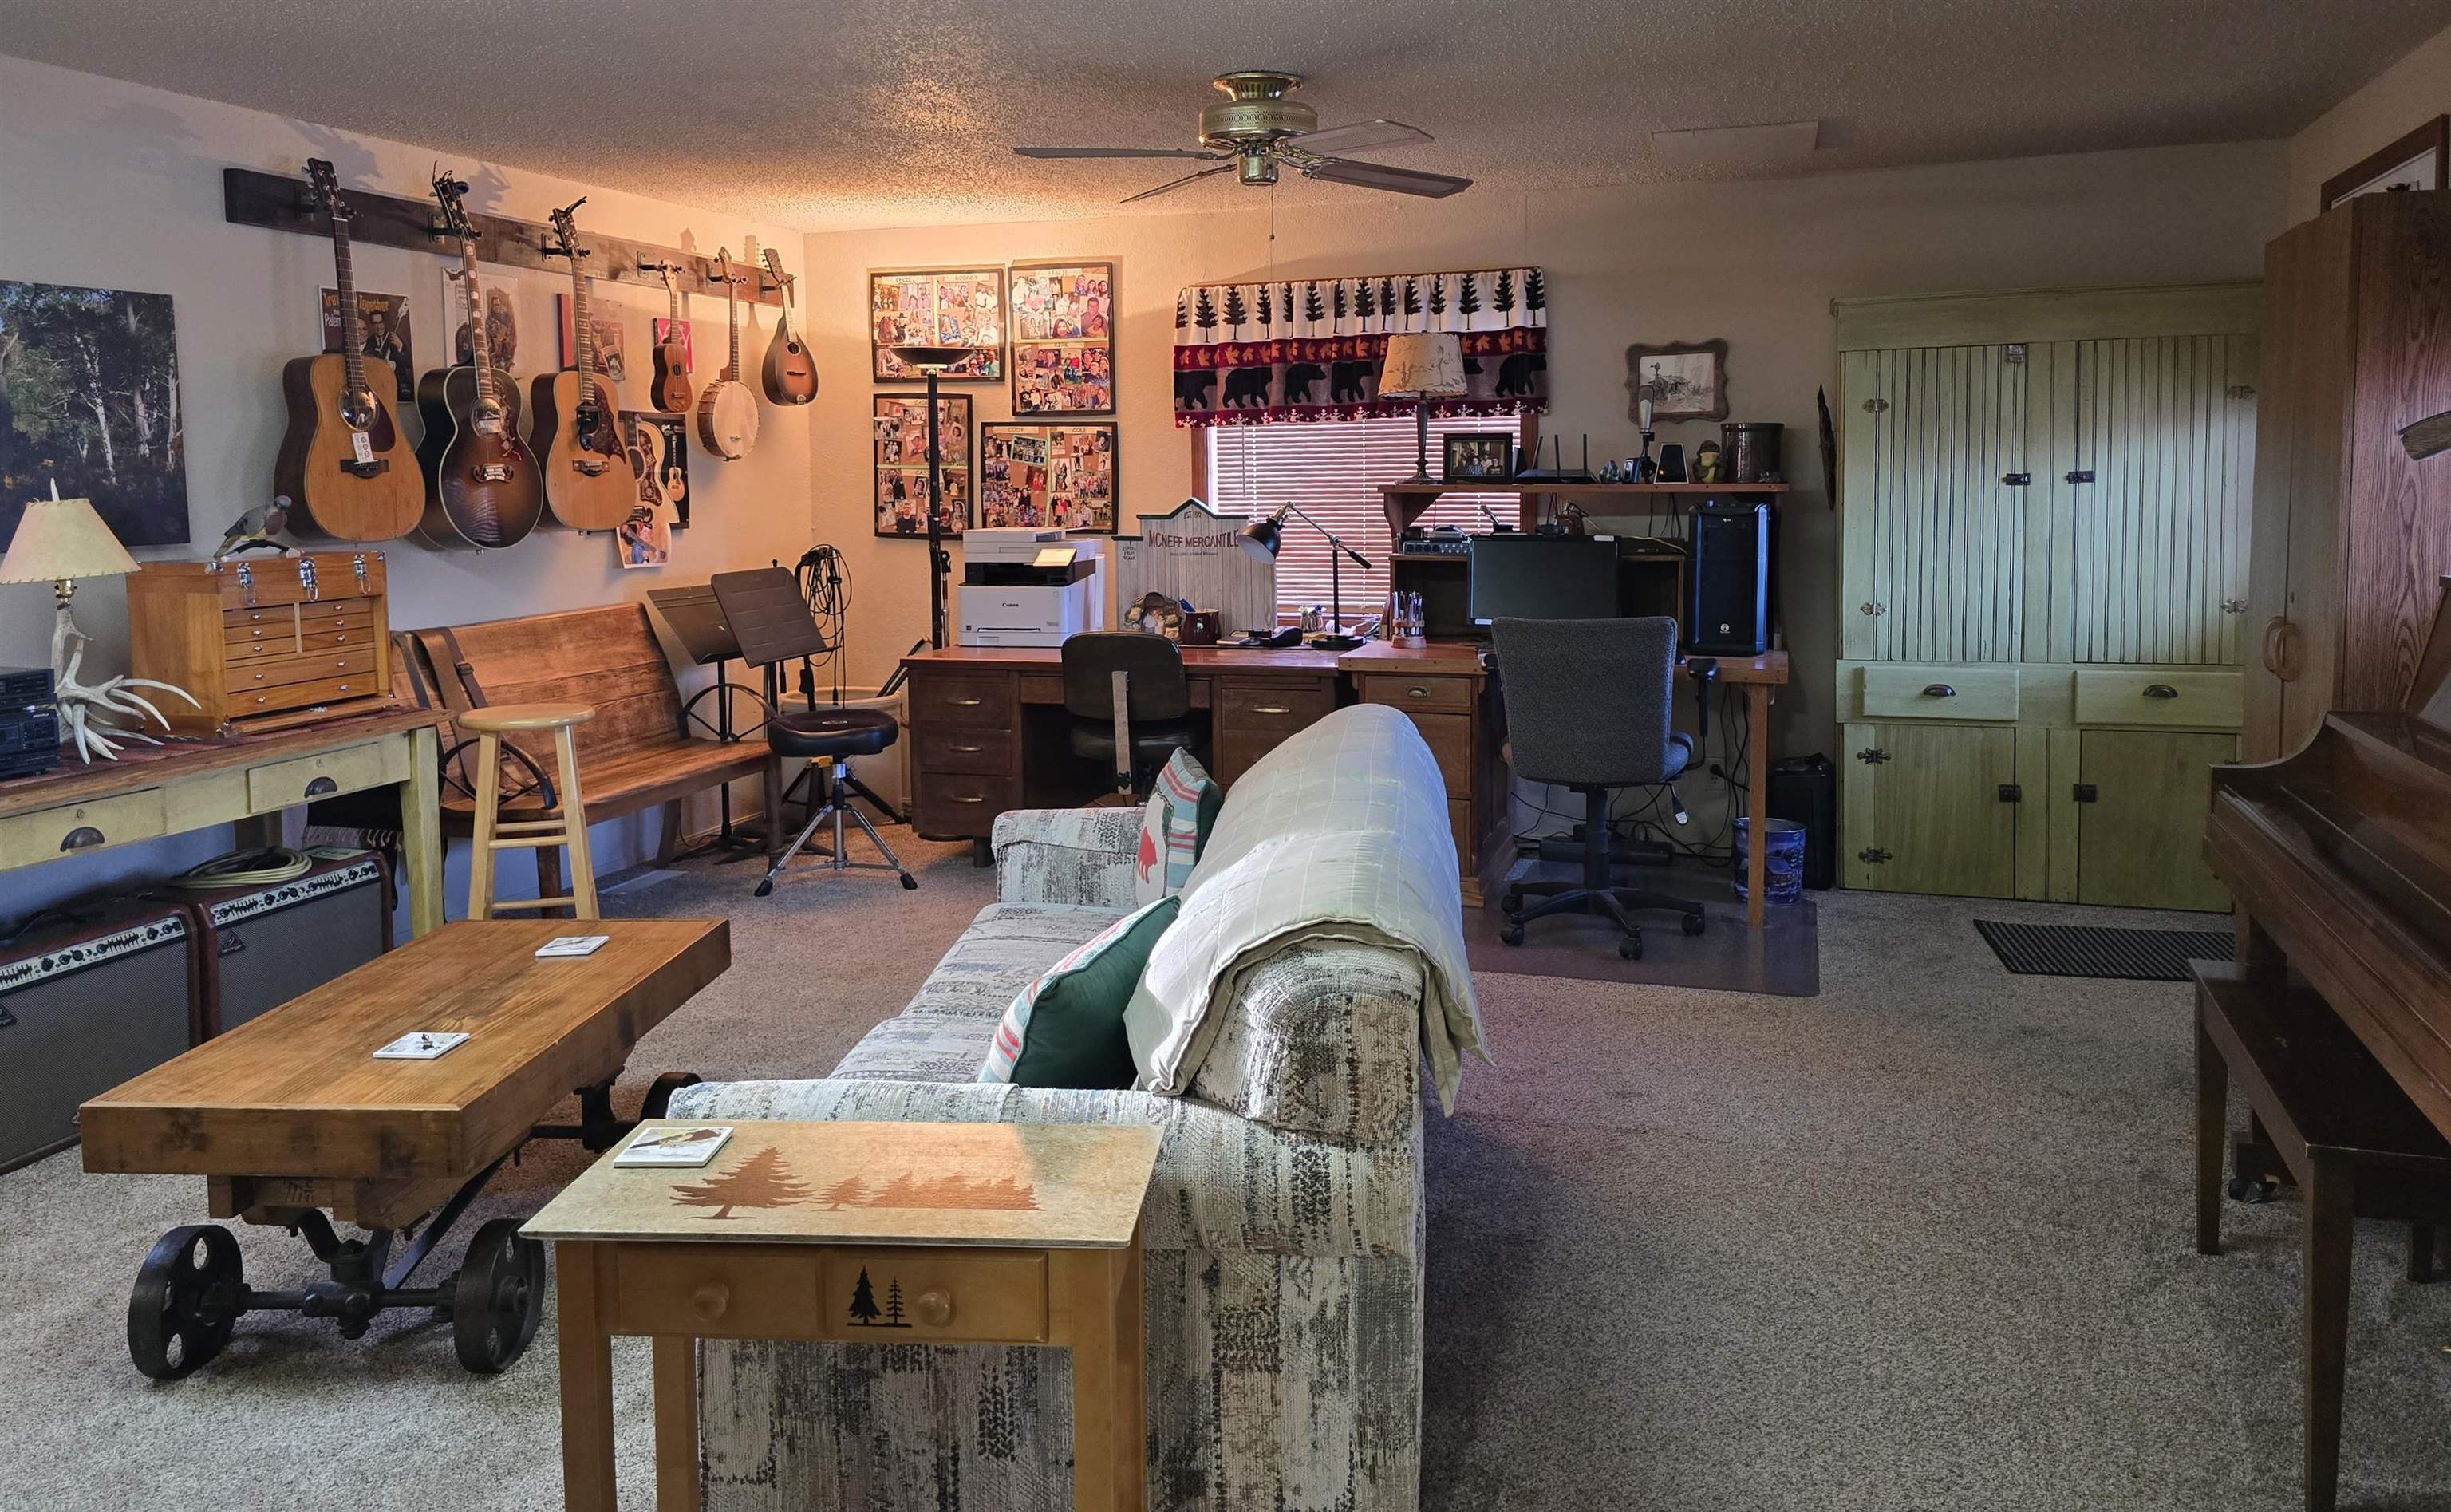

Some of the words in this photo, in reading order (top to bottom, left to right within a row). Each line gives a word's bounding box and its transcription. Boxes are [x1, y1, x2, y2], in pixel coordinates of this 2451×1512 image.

[359, 295, 389, 314] Together
[1149, 530, 1182, 548] MCNEFF
[1186, 529, 1239, 548] MERCANTILE
